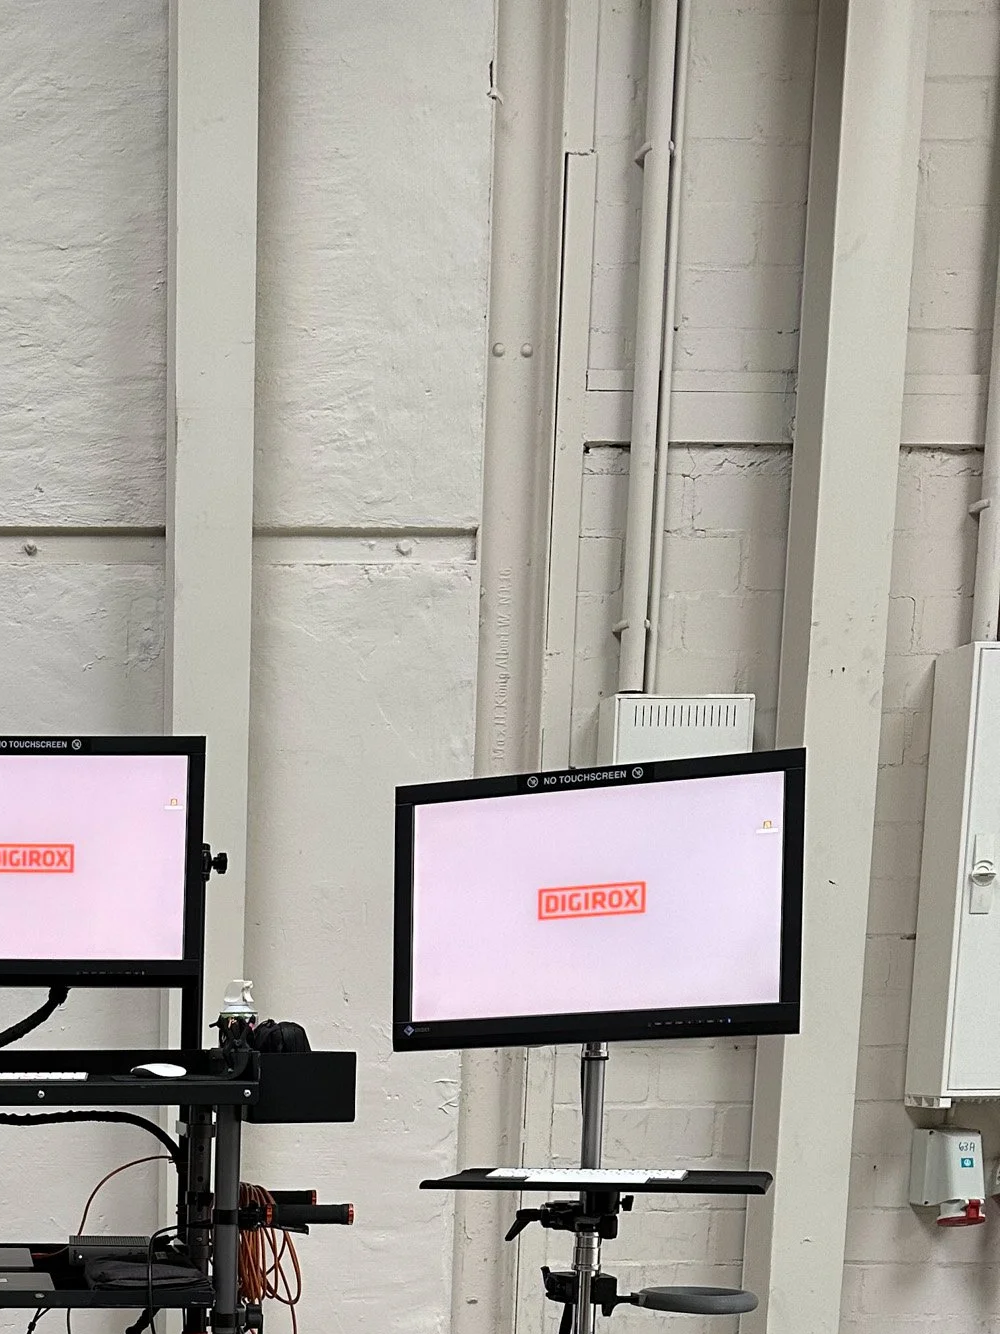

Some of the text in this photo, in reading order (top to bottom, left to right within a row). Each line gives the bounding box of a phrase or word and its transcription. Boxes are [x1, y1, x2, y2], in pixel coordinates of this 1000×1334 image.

[9, 740, 68, 749] TOUCHSCREEN
[543, 770, 627, 786] NO TOUCHSCREEN
[544, 888, 639, 914] DIGIROX
